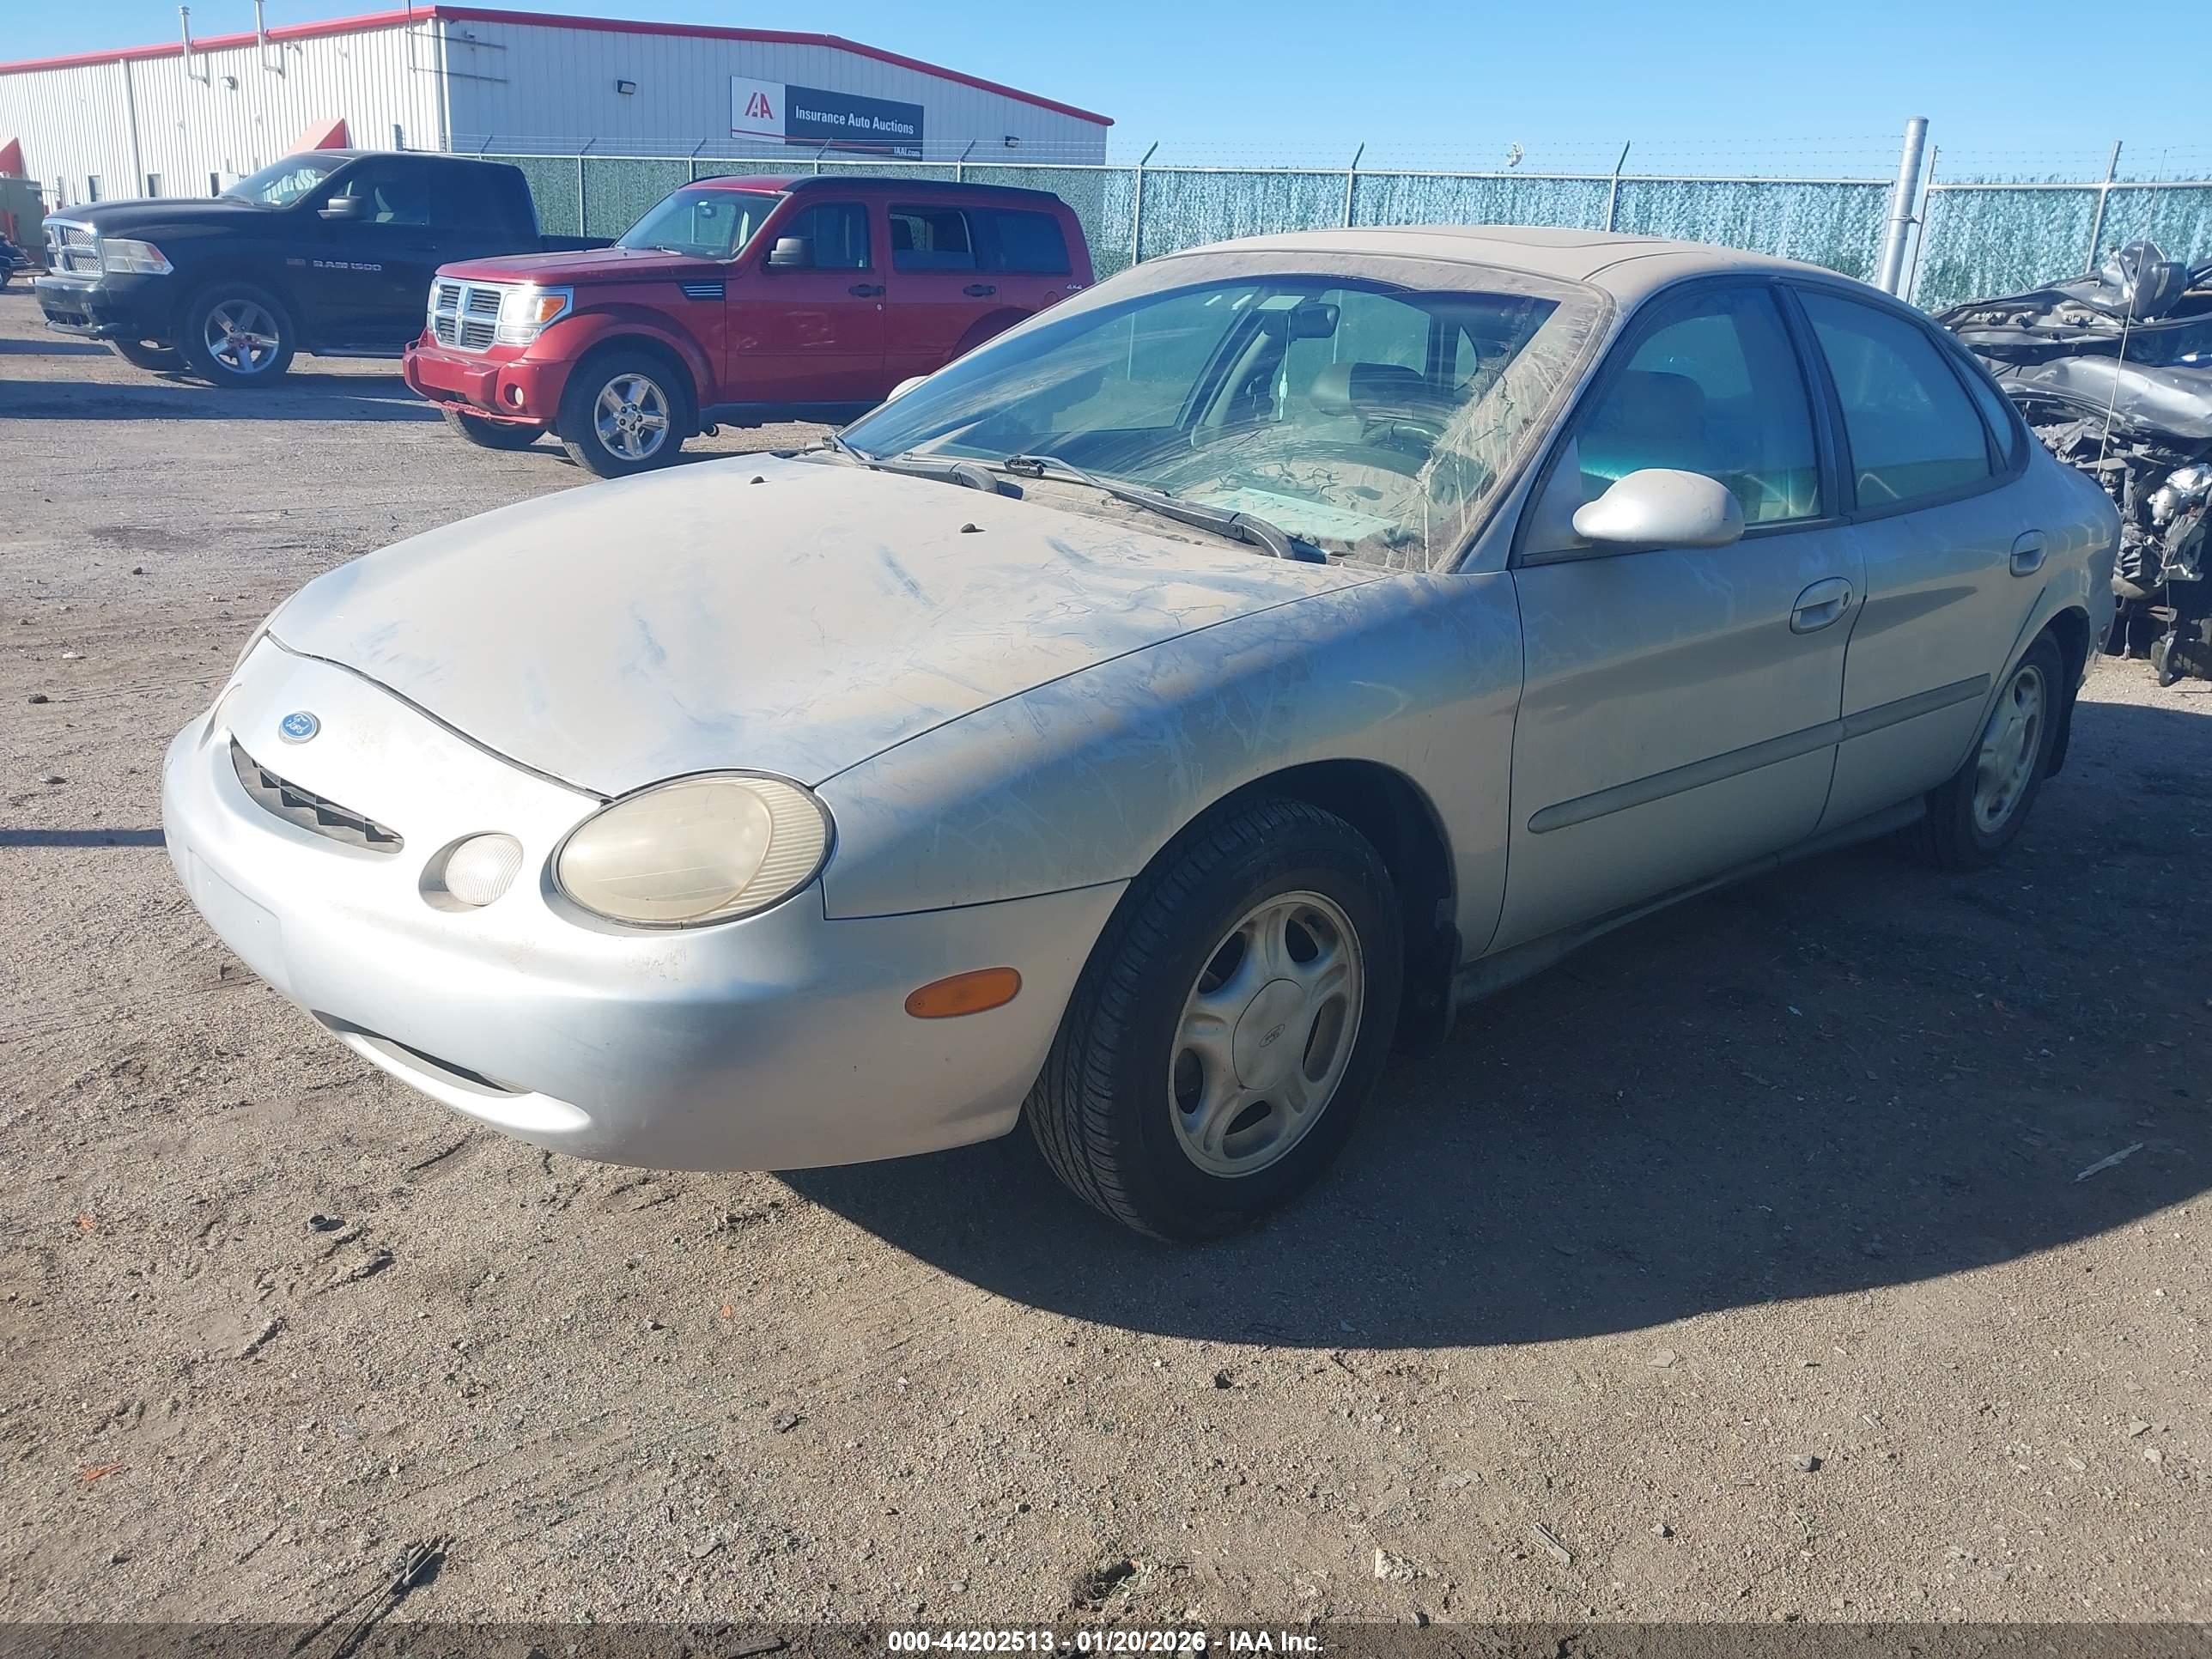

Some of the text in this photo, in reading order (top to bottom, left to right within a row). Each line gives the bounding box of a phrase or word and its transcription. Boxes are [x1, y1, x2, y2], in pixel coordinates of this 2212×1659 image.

[795, 106, 915, 135] Insurance Auto Auctions
[313, 260, 348, 269] RAM
[350, 263, 382, 271] 1500
[285, 714, 318, 734] Ford
